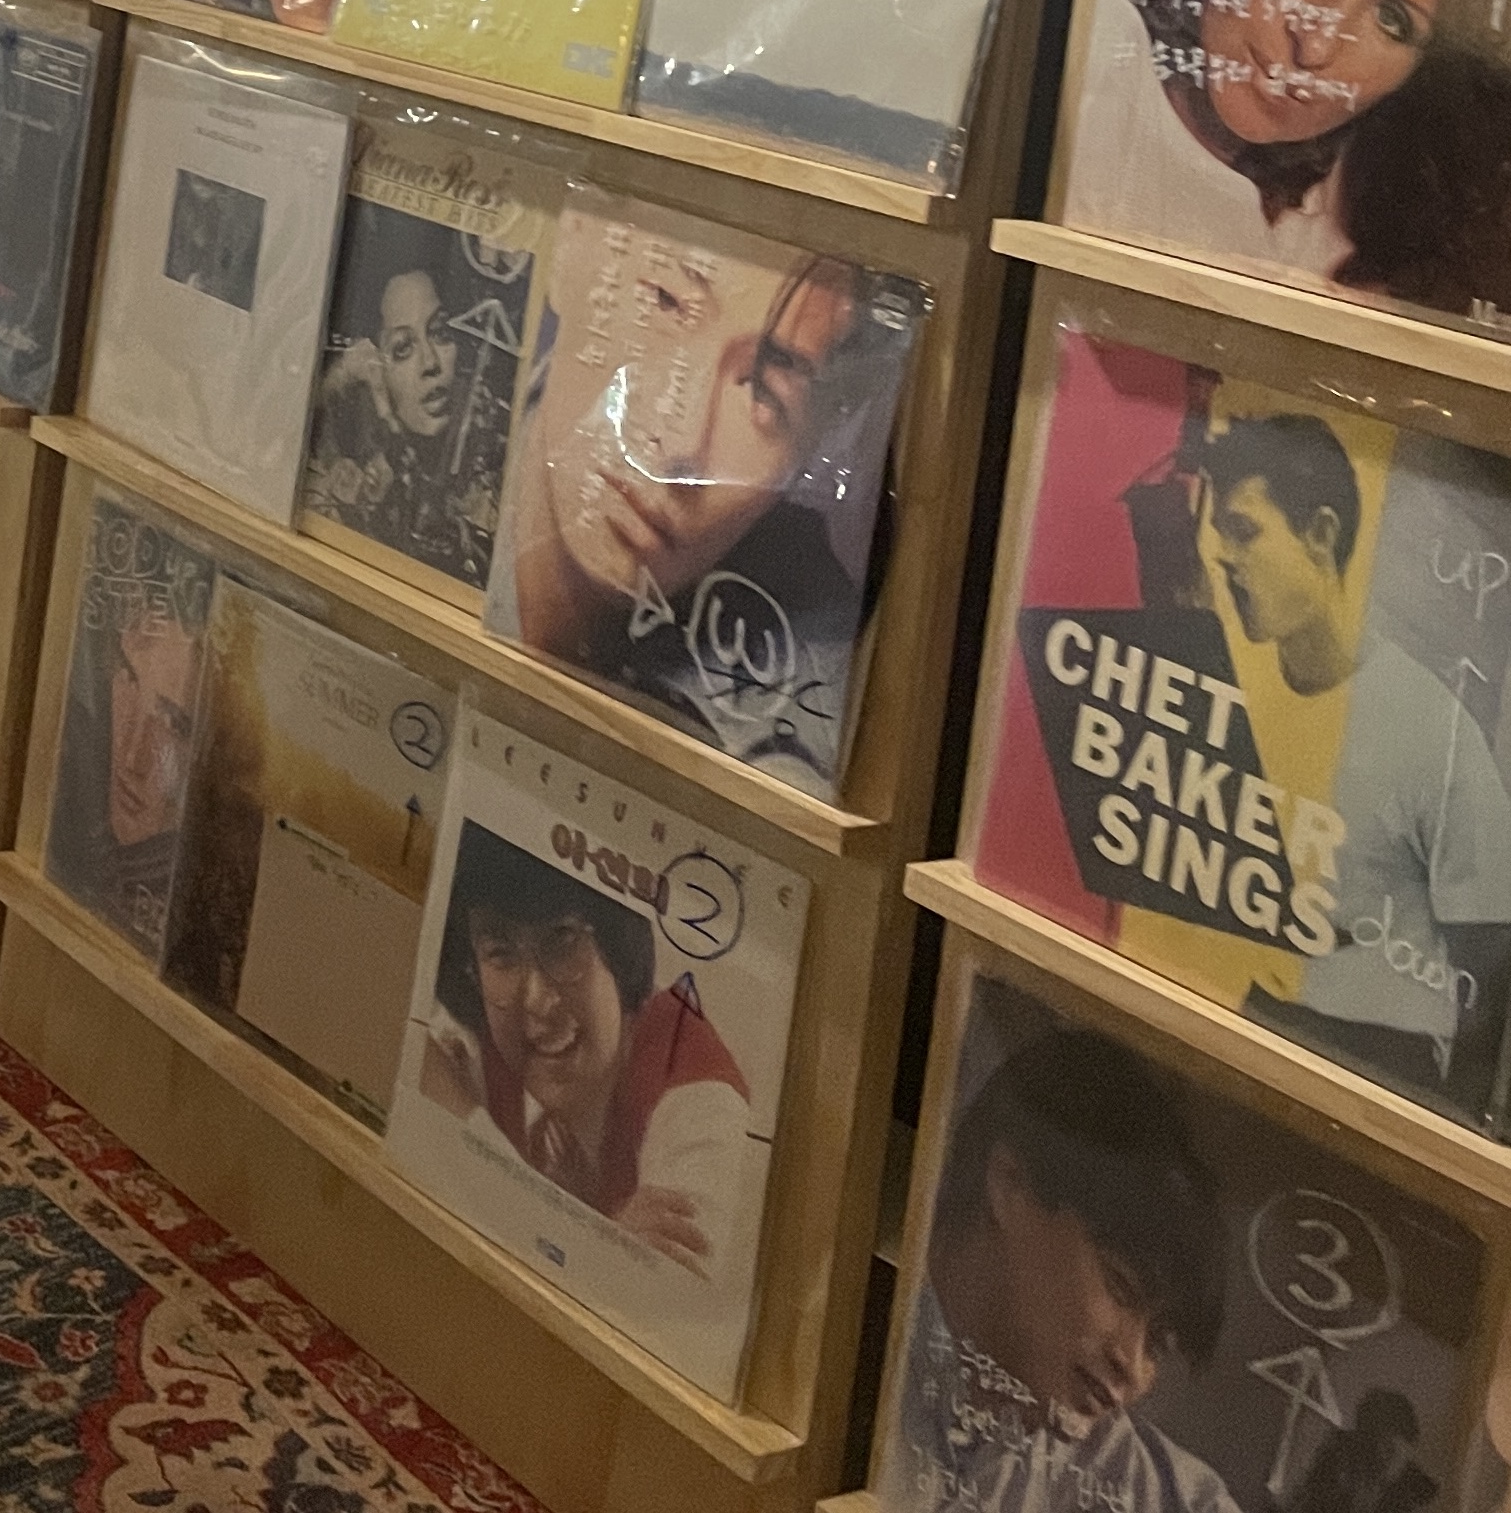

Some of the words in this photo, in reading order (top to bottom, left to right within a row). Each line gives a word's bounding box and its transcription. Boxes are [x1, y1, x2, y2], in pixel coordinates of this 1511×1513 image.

[1430, 538, 1510, 622] up
[1044, 619, 1247, 750] CHET
[1072, 703, 1348, 882] BAKER
[1092, 794, 1340, 958] SINGS
